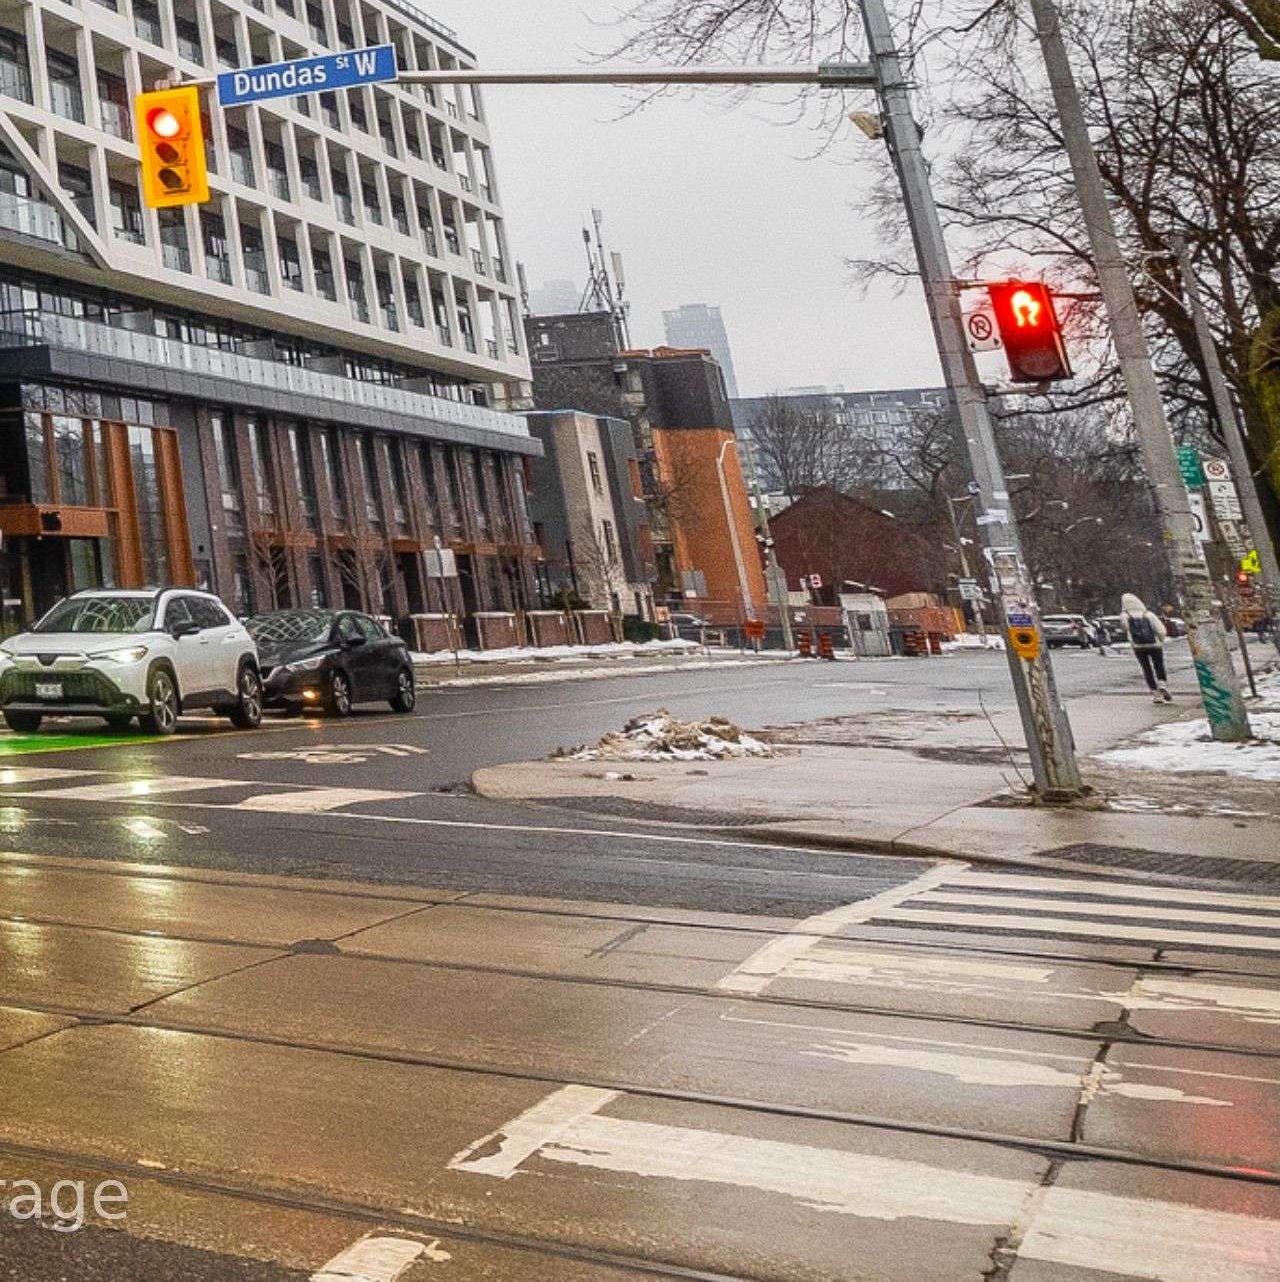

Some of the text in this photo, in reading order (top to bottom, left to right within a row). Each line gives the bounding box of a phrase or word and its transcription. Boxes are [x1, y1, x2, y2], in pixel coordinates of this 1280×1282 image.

[233, 50, 378, 97] Dundas St W
